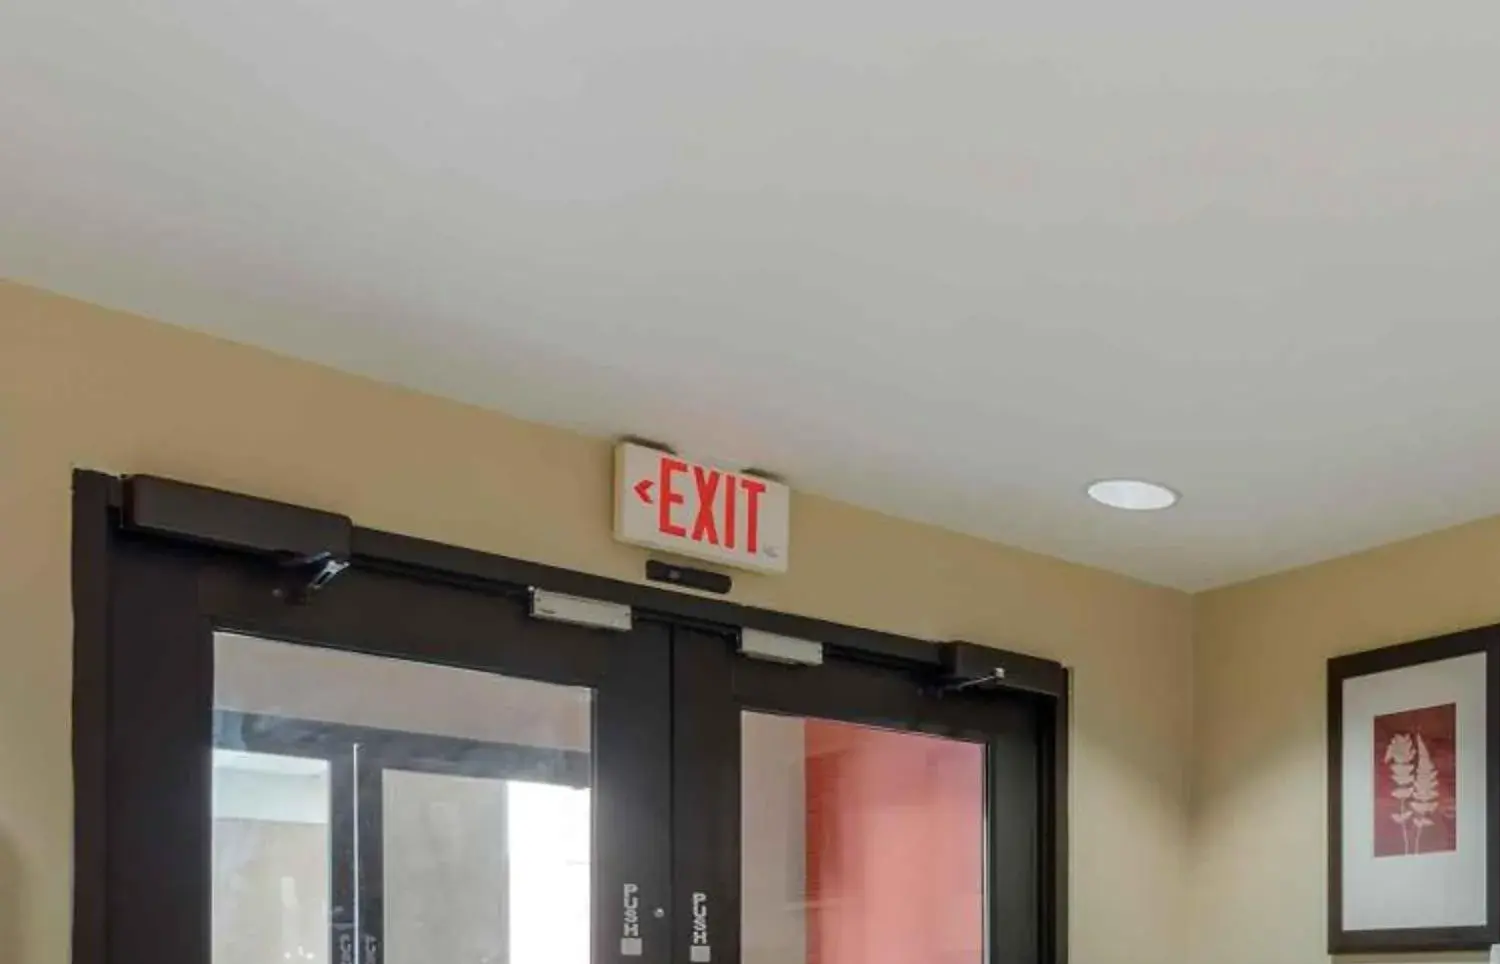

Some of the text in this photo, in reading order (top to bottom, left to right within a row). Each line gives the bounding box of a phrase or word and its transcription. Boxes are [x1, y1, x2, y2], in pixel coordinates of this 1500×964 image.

[659, 457, 766, 554] EXIT
[623, 883, 639, 936] PUSH
[692, 892, 707, 944] PUSH
